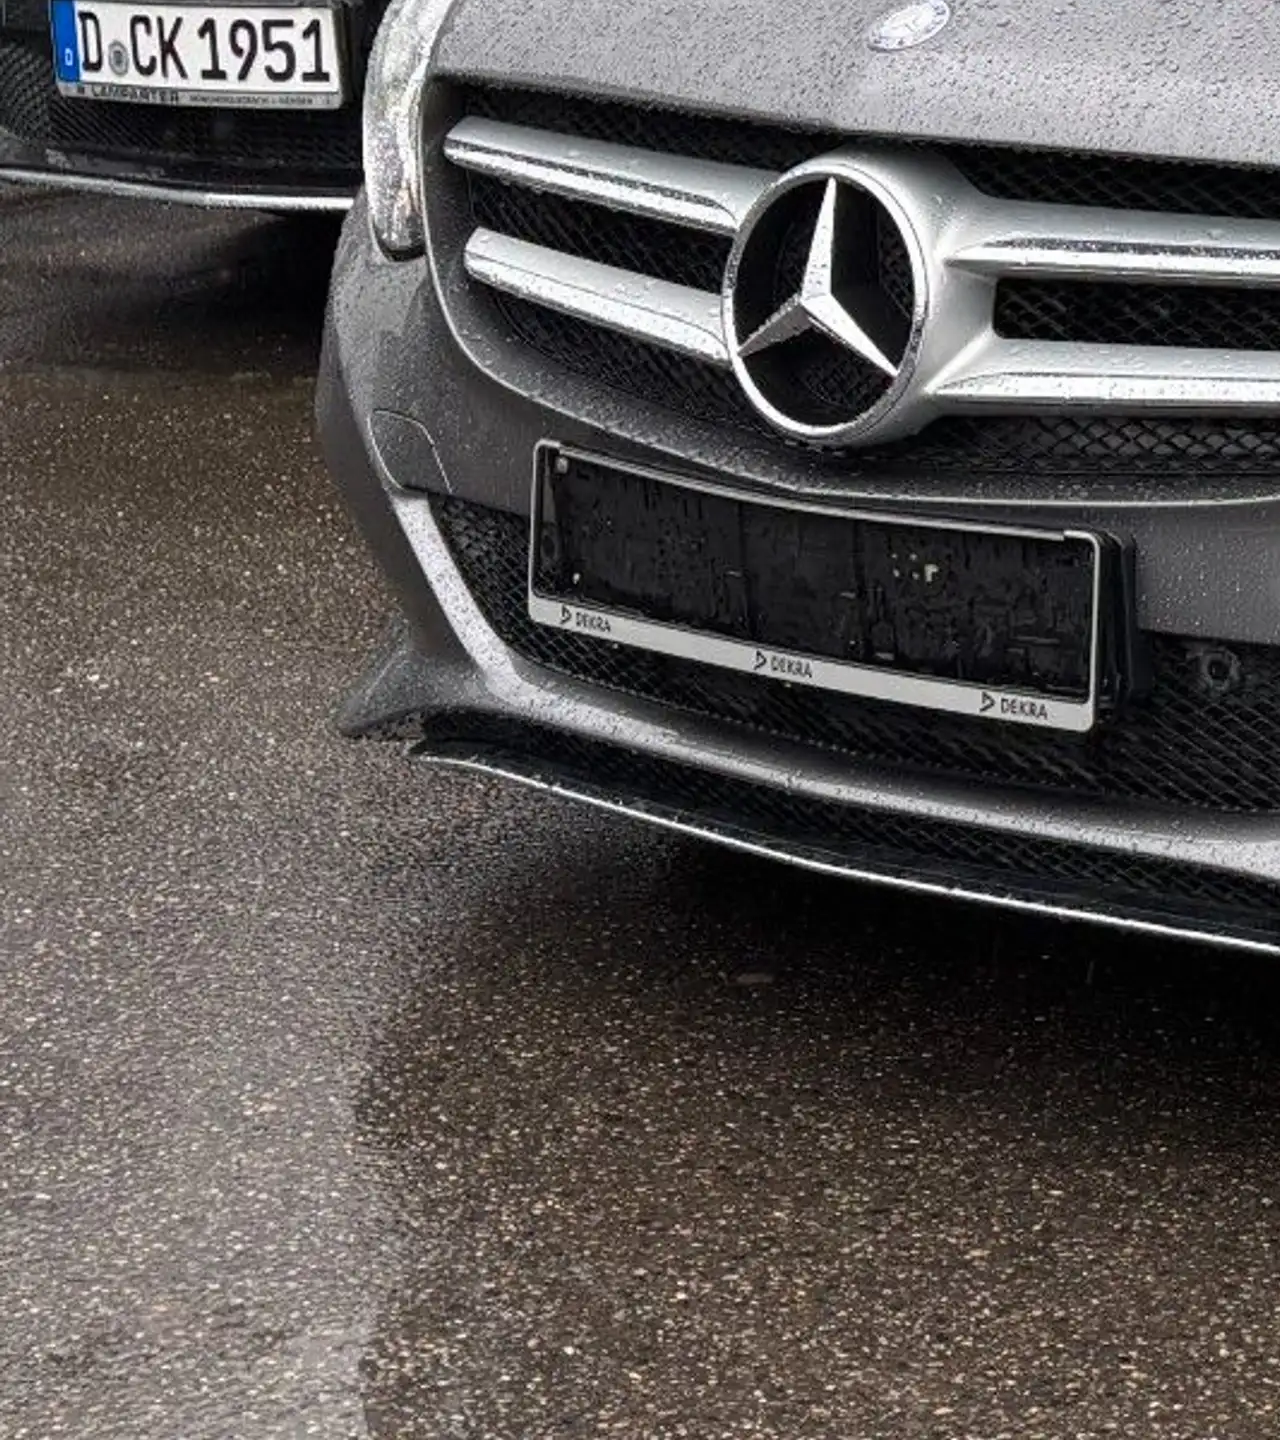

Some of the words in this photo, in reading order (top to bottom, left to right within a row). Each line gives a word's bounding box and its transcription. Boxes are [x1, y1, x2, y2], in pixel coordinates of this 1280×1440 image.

[78, 11, 101, 72] D
[575, 611, 611, 633] DEKRA
[771, 654, 812, 678] DEKRA
[1001, 697, 1048, 720] DEKRA
